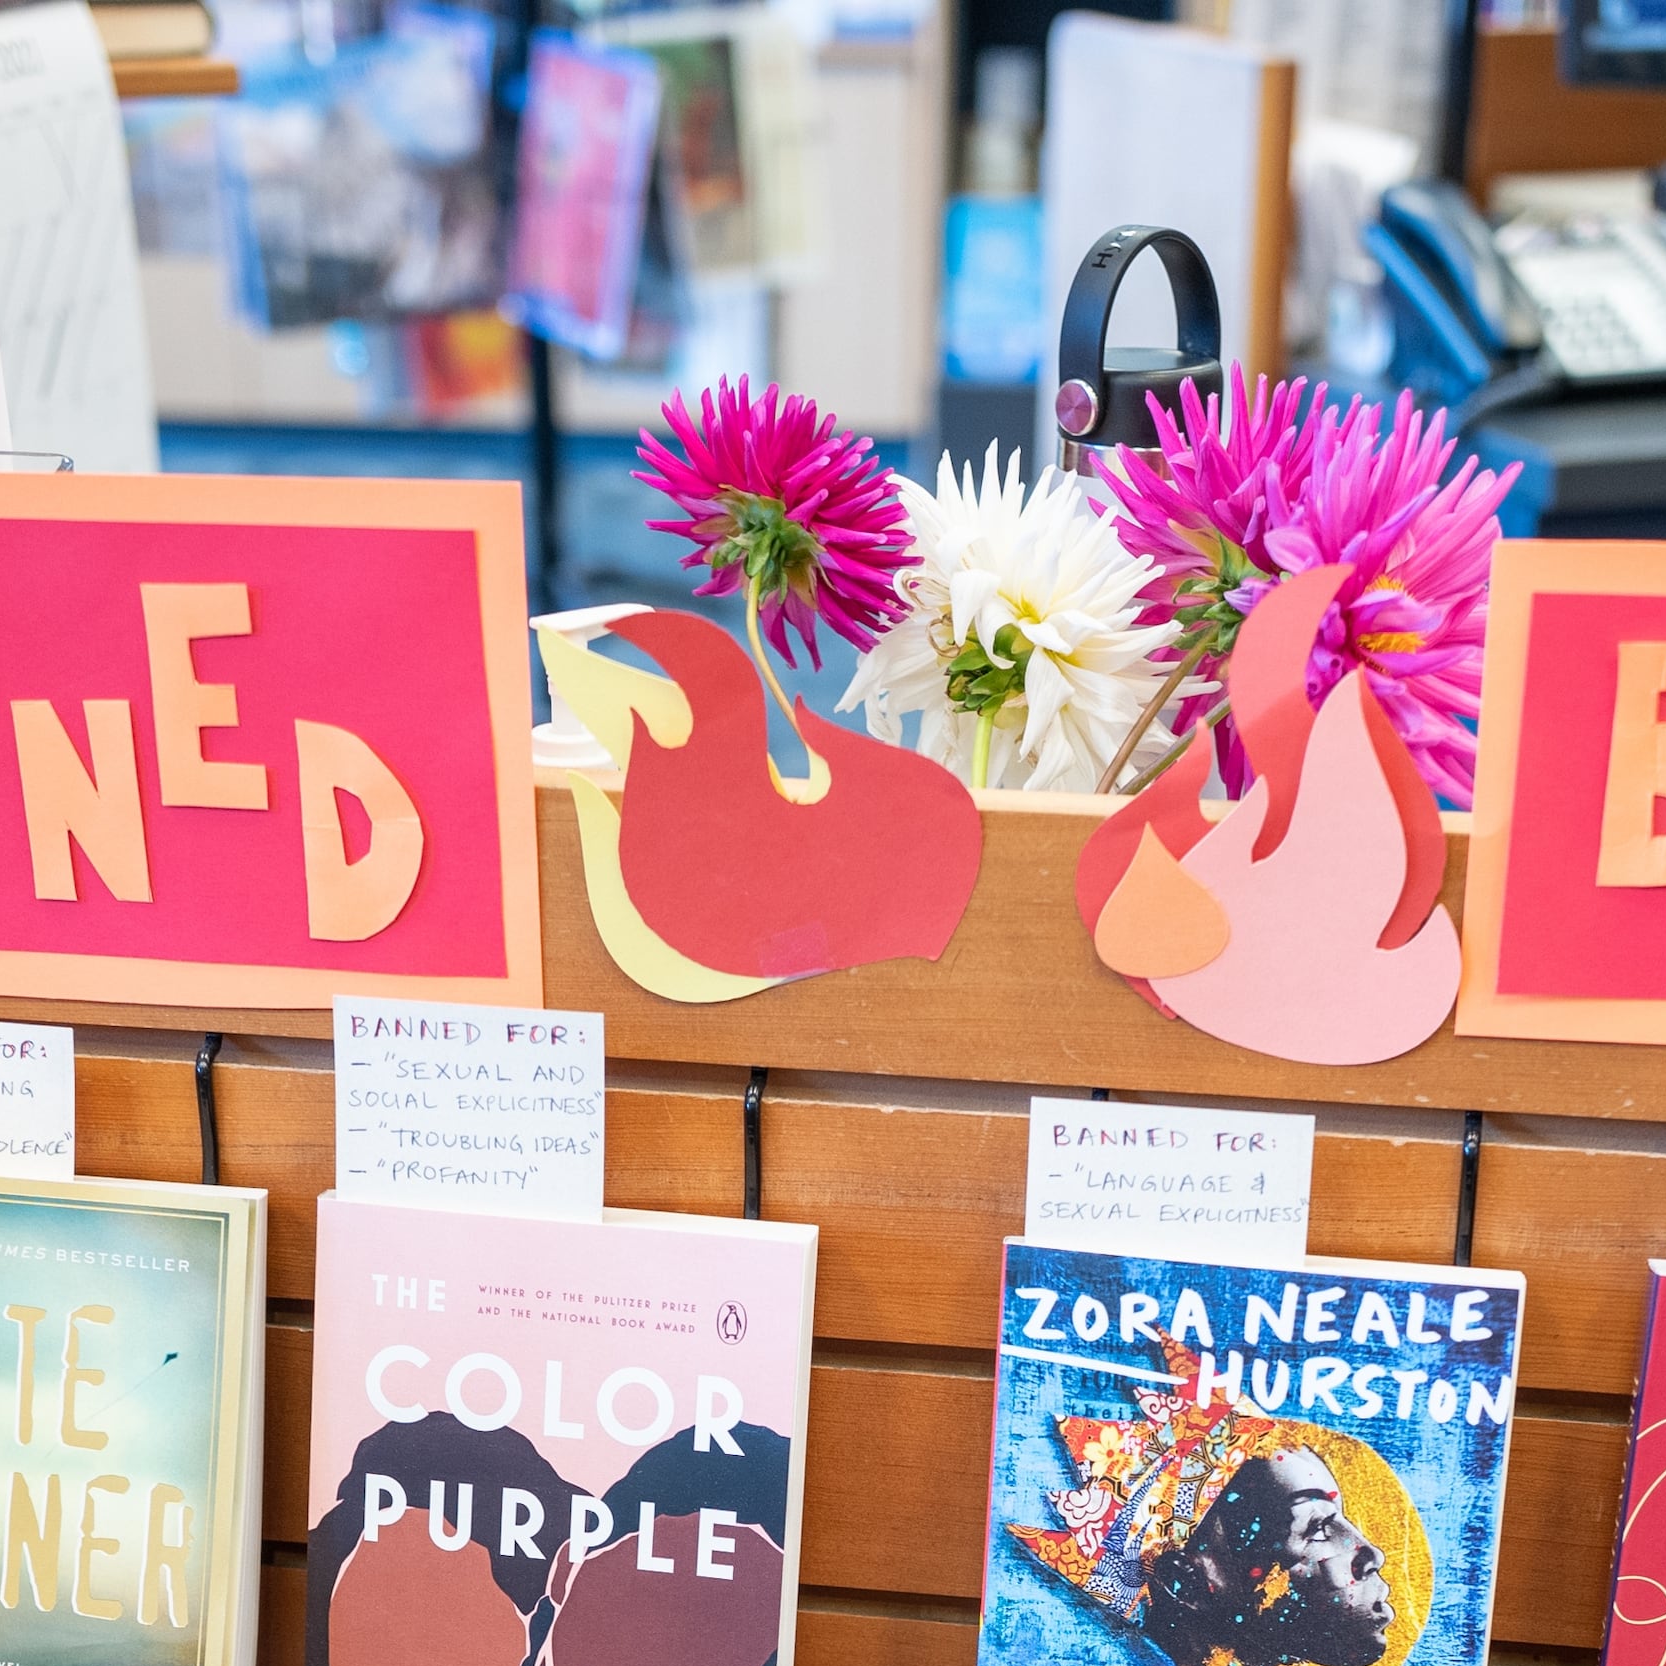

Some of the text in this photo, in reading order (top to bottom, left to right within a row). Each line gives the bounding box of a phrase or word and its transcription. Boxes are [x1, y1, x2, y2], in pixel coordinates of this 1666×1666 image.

[350, 1015, 587, 1046] BANNED FOR:
[1053, 1123, 1277, 1153] BANNED FOR:
[56, 1249, 190, 1273] BESTSELLER
[371, 1274, 446, 1312] THE
[478, 1284, 697, 1314] WINNER OF THE PULITZER PRIZE
[1014, 1282, 1493, 1344] ZORA NEALE
[364, 1344, 746, 1458] COLOR
[1195, 1351, 1512, 1426] HURSTON
[363, 1473, 738, 1580] PURPLE
